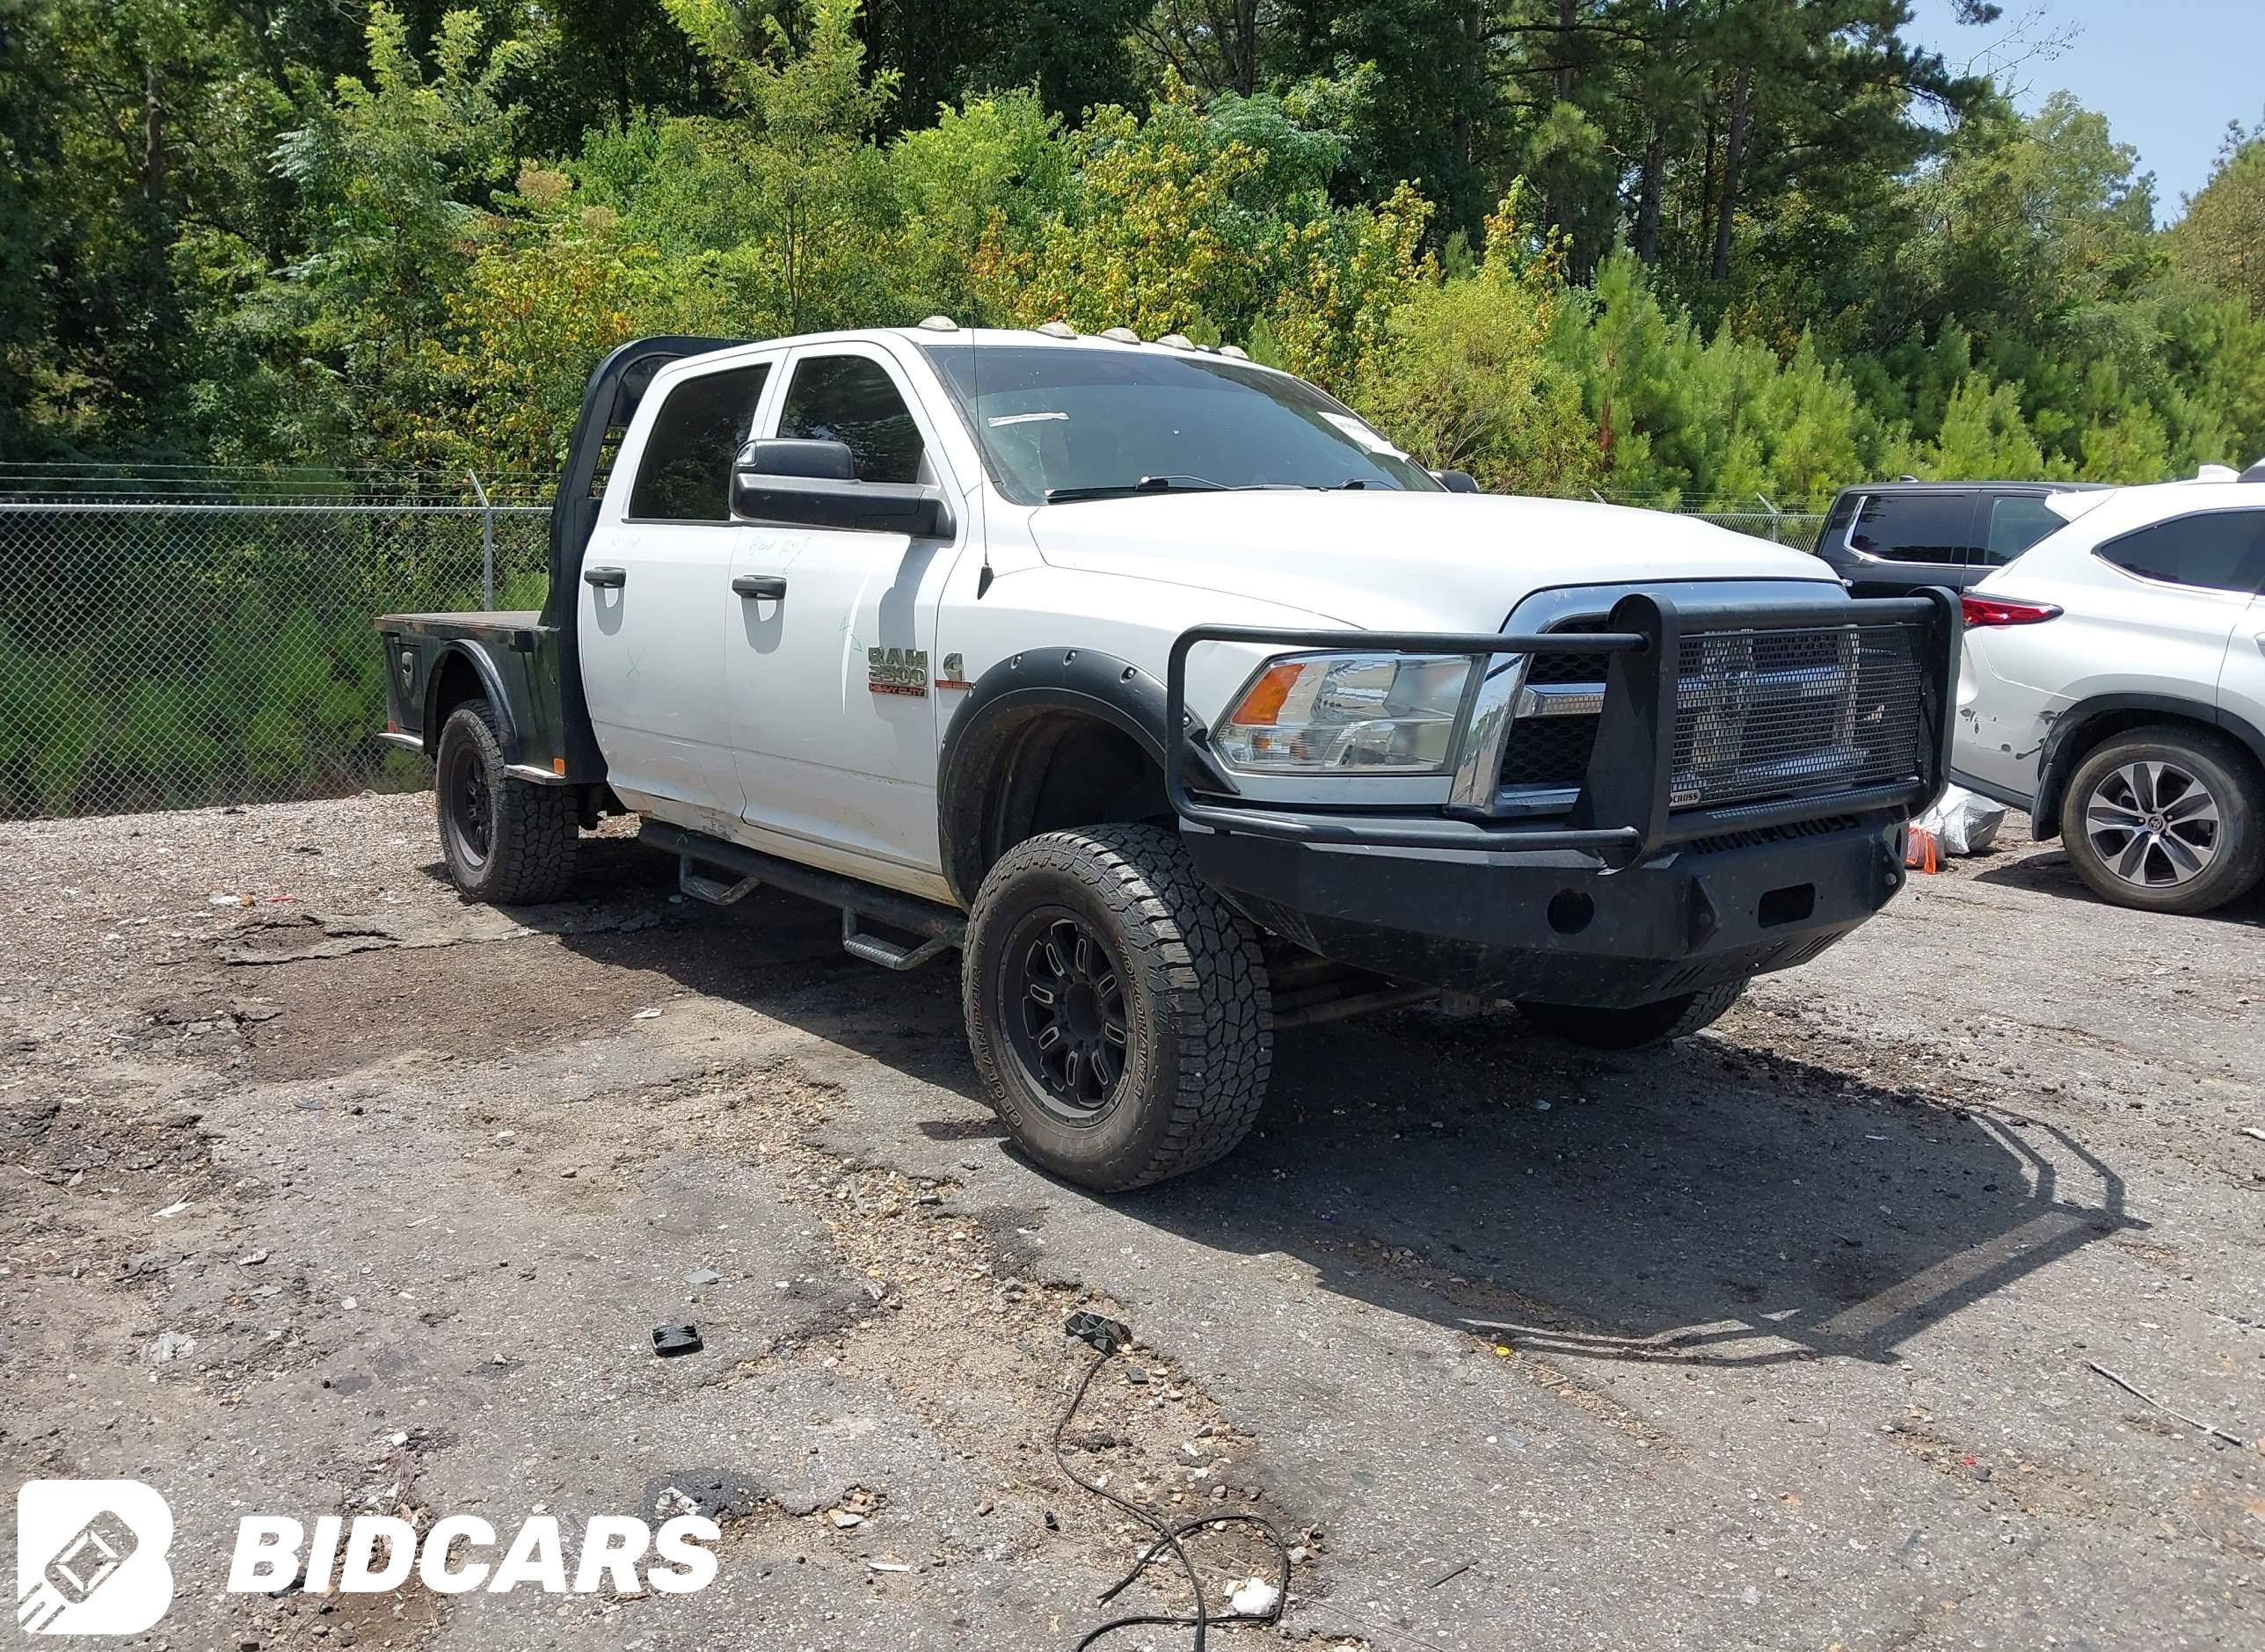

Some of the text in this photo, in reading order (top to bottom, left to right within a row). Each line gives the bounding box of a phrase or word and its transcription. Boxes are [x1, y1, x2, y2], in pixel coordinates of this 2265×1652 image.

[868, 647, 928, 668] RAM
[869, 665, 928, 686] 2500
[870, 684, 924, 696] HEAVY DUTY
[1115, 936, 1149, 1097] YOKOHAMA
[972, 965, 1023, 1126] GEOLANDAR
